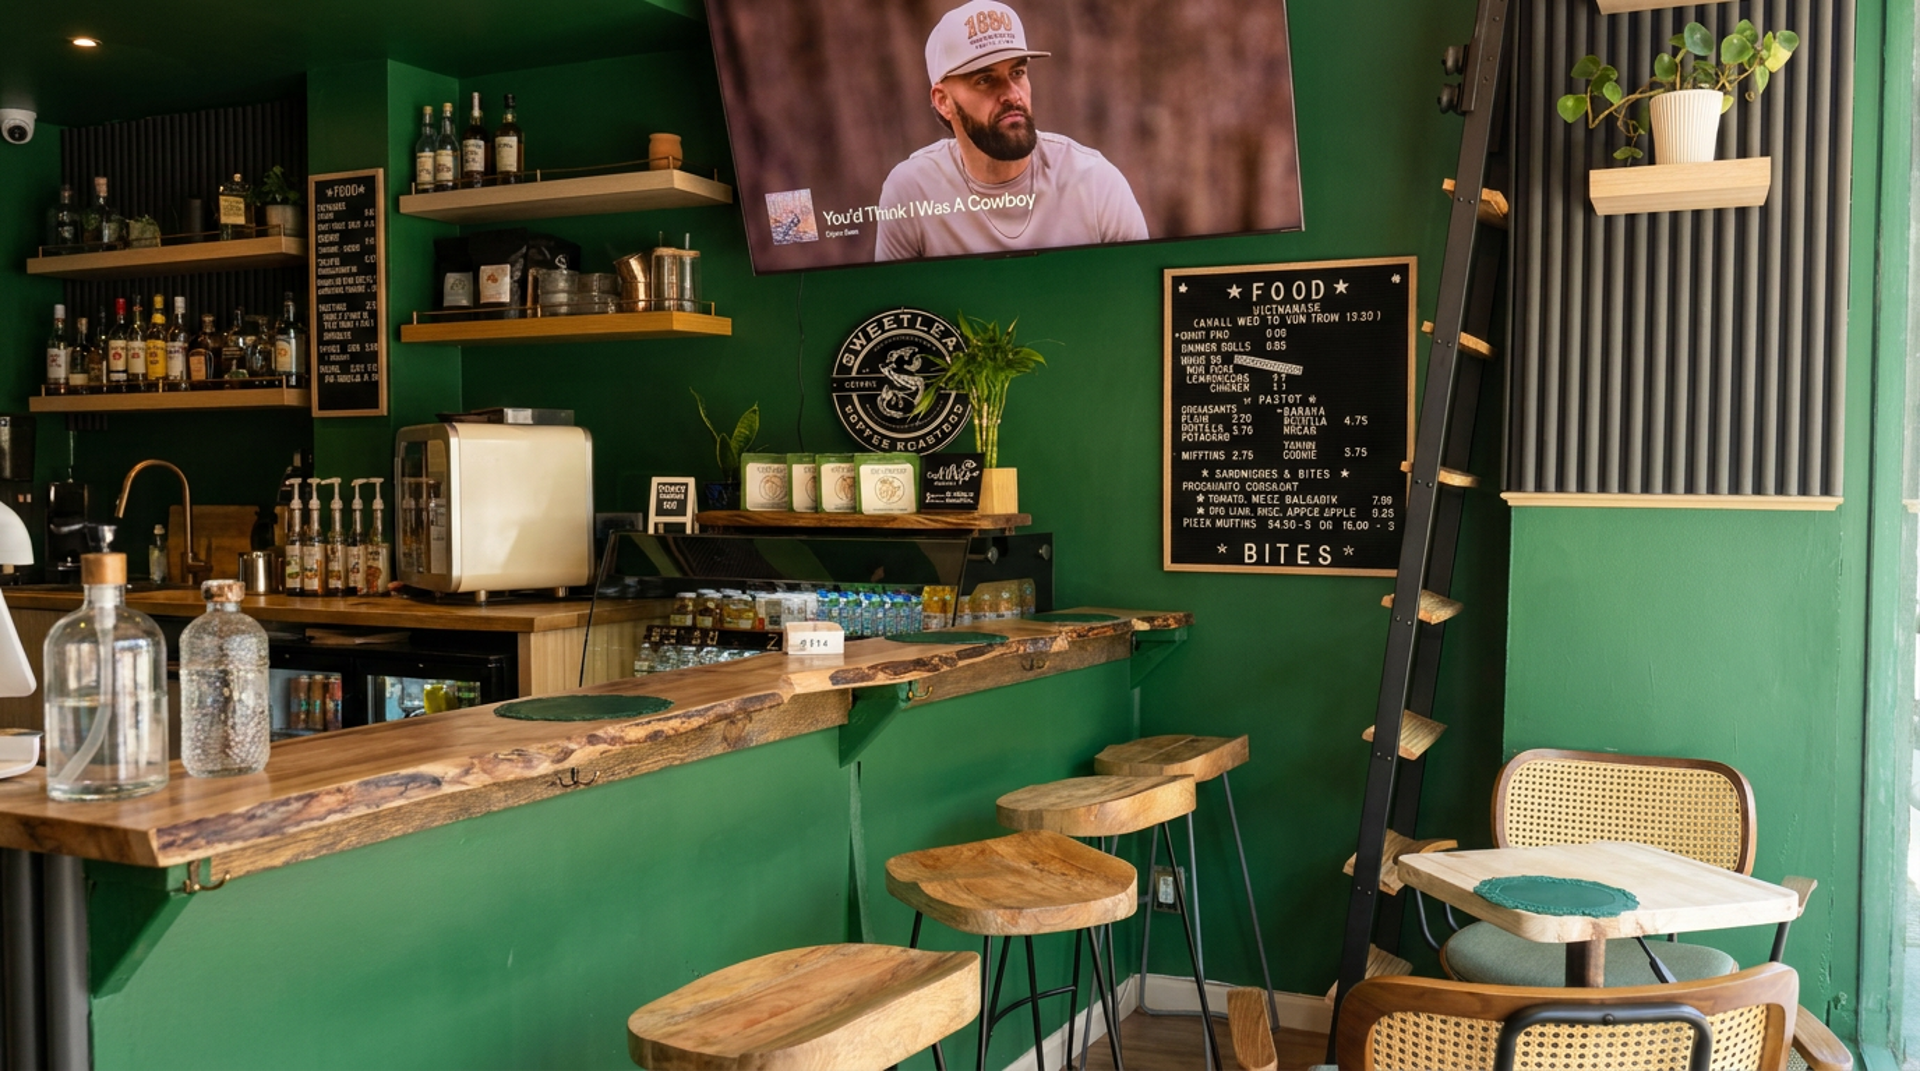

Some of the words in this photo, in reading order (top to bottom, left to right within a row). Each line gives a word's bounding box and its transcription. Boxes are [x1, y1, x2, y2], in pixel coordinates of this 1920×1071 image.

[823, 207, 863, 226] You'd
[865, 203, 907, 222] Think
[909, 201, 914, 218] I
[916, 200, 951, 217] Was
[953, 197, 966, 213] A
[967, 192, 1036, 211] Cowboy
[1253, 280, 1324, 301] FOOD
[1265, 314, 1281, 326] TO
[1284, 470, 1290, 478] &
[1299, 469, 1330, 478] BITES
[1243, 541, 1333, 565] BITES
